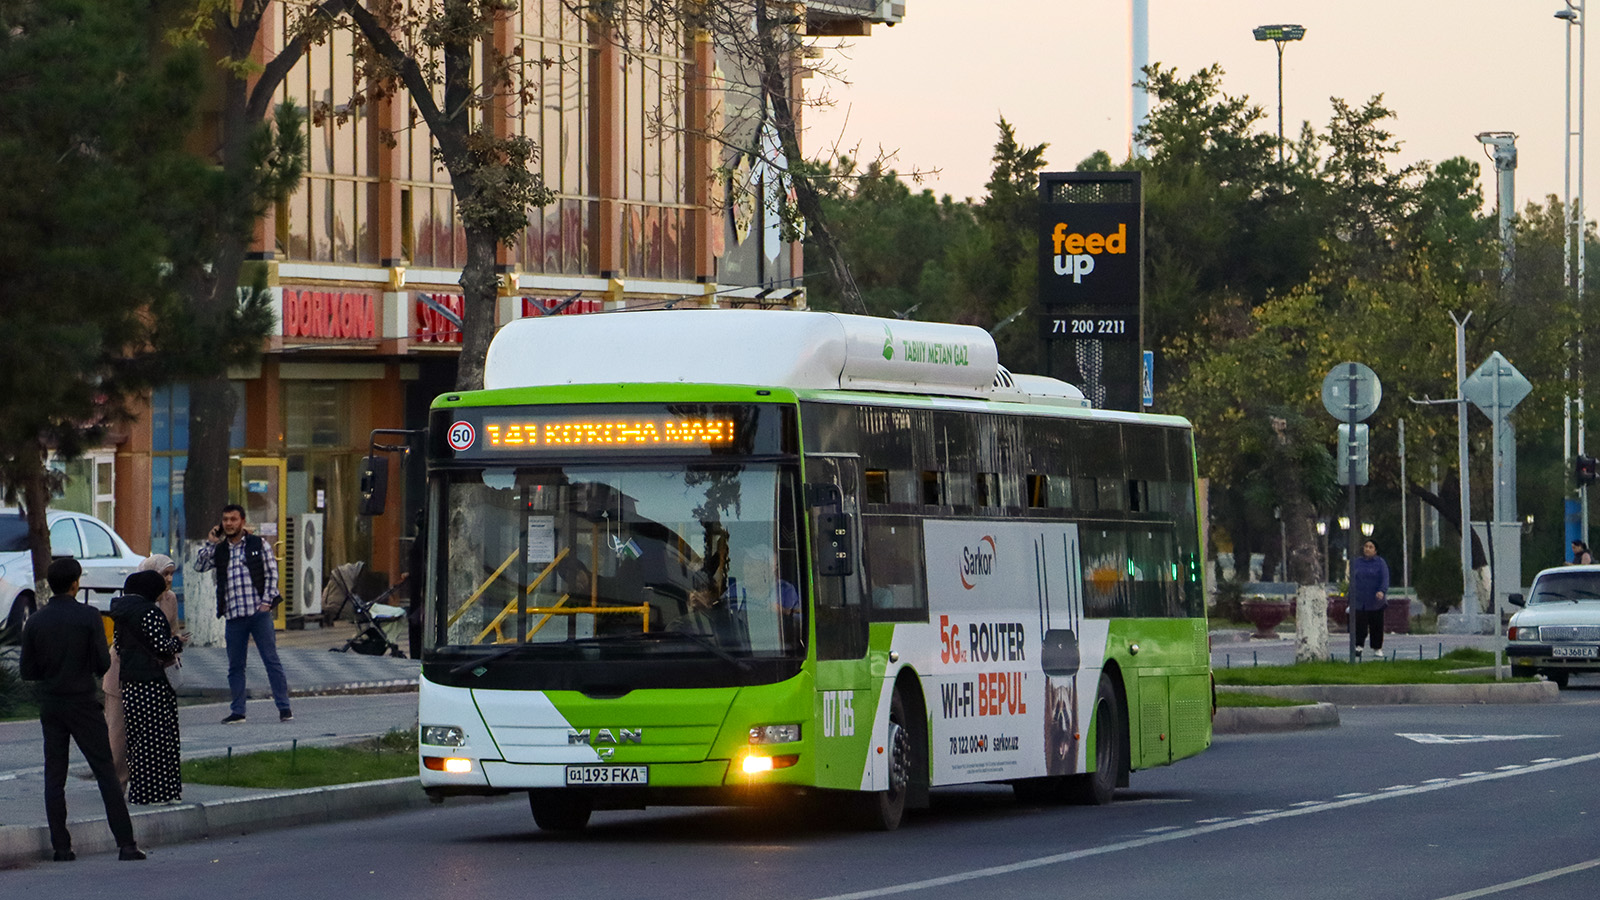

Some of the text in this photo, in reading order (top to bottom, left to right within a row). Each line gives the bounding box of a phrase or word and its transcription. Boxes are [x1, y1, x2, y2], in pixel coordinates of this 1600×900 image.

[1052, 222, 1127, 255] feed
[1053, 253, 1095, 284] up
[283, 290, 376, 339] DORIXONA
[1052, 320, 1125, 334] 71 200 2211
[928, 342, 952, 365] METAN
[954, 344, 969, 367] GAZ
[452, 429, 471, 442] 50
[486, 424, 536, 444] 141
[963, 545, 993, 576] Sarkor
[969, 622, 1026, 663] ROUTER
[940, 671, 1027, 719] WI-FI BEPUL
[823, 690, 836, 737] 07
[567, 728, 642, 745] MAN
[993, 733, 1019, 752] sarkor.uz
[569, 768, 639, 782] 01 193 FKA
